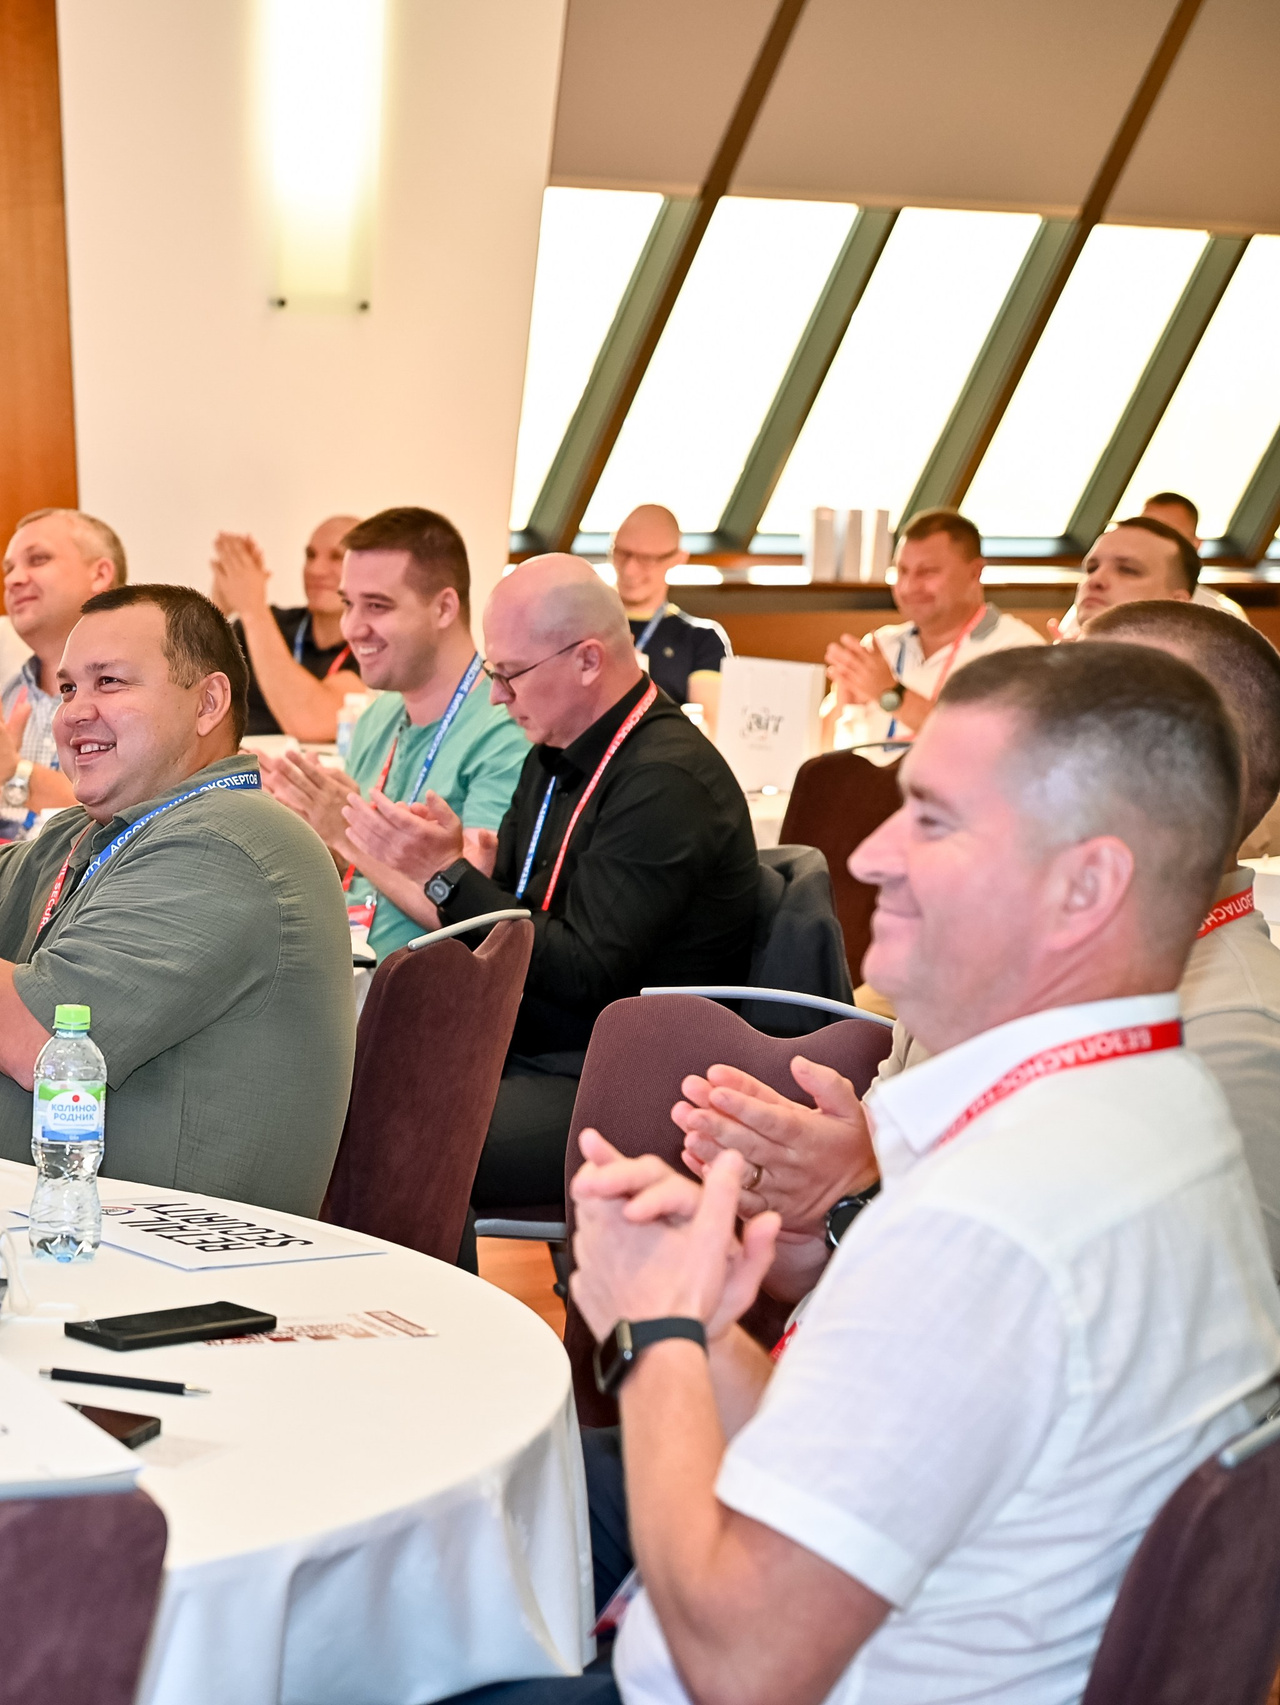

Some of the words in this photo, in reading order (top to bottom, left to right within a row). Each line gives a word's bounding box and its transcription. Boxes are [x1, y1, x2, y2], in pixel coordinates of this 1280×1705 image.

[38, 883, 61, 930] SECUR
[53, 1113, 94, 1121] РОДНИК
[118, 1216, 256, 1252] RETAIL
[131, 1202, 314, 1249] SECURITY
